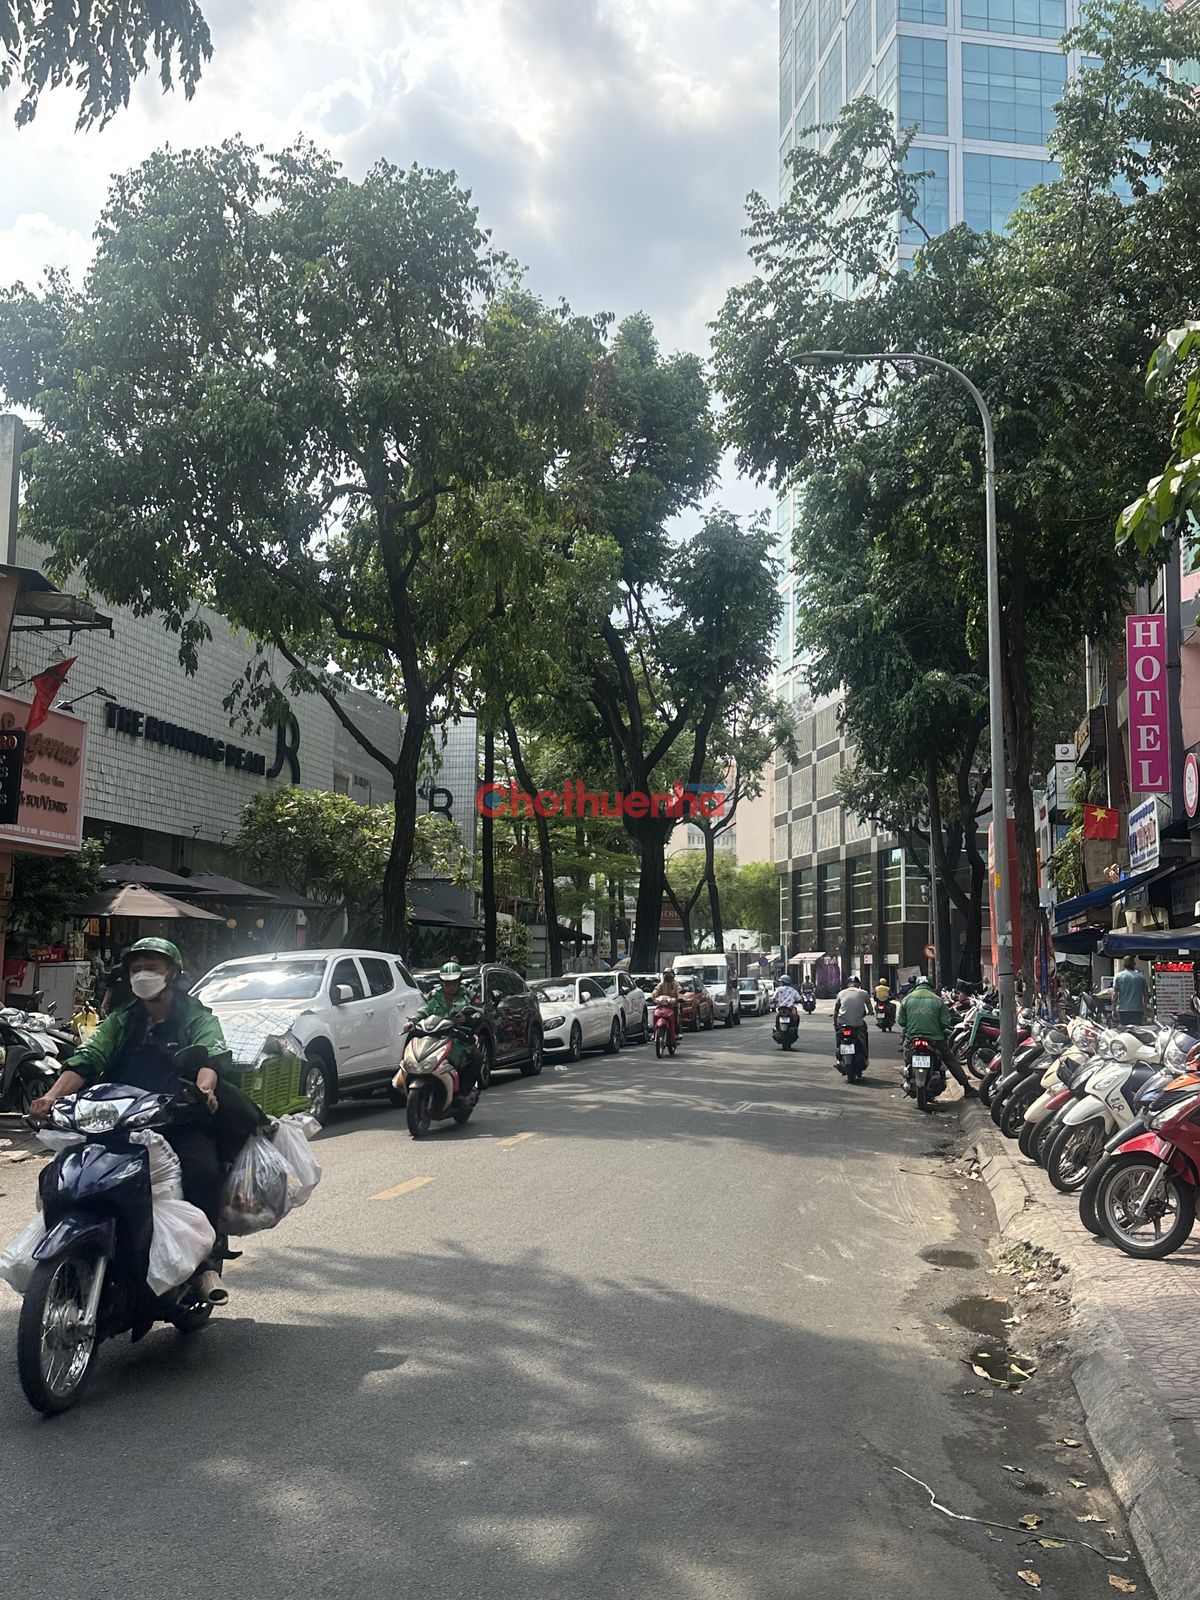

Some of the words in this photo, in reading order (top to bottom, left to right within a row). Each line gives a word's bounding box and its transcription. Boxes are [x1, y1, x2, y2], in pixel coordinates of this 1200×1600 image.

[105, 702, 145, 738] THE
[145, 716, 225, 763] RUNNING
[225, 743, 266, 776] BEAN
[1132, 619, 1164, 788] HOTEL
